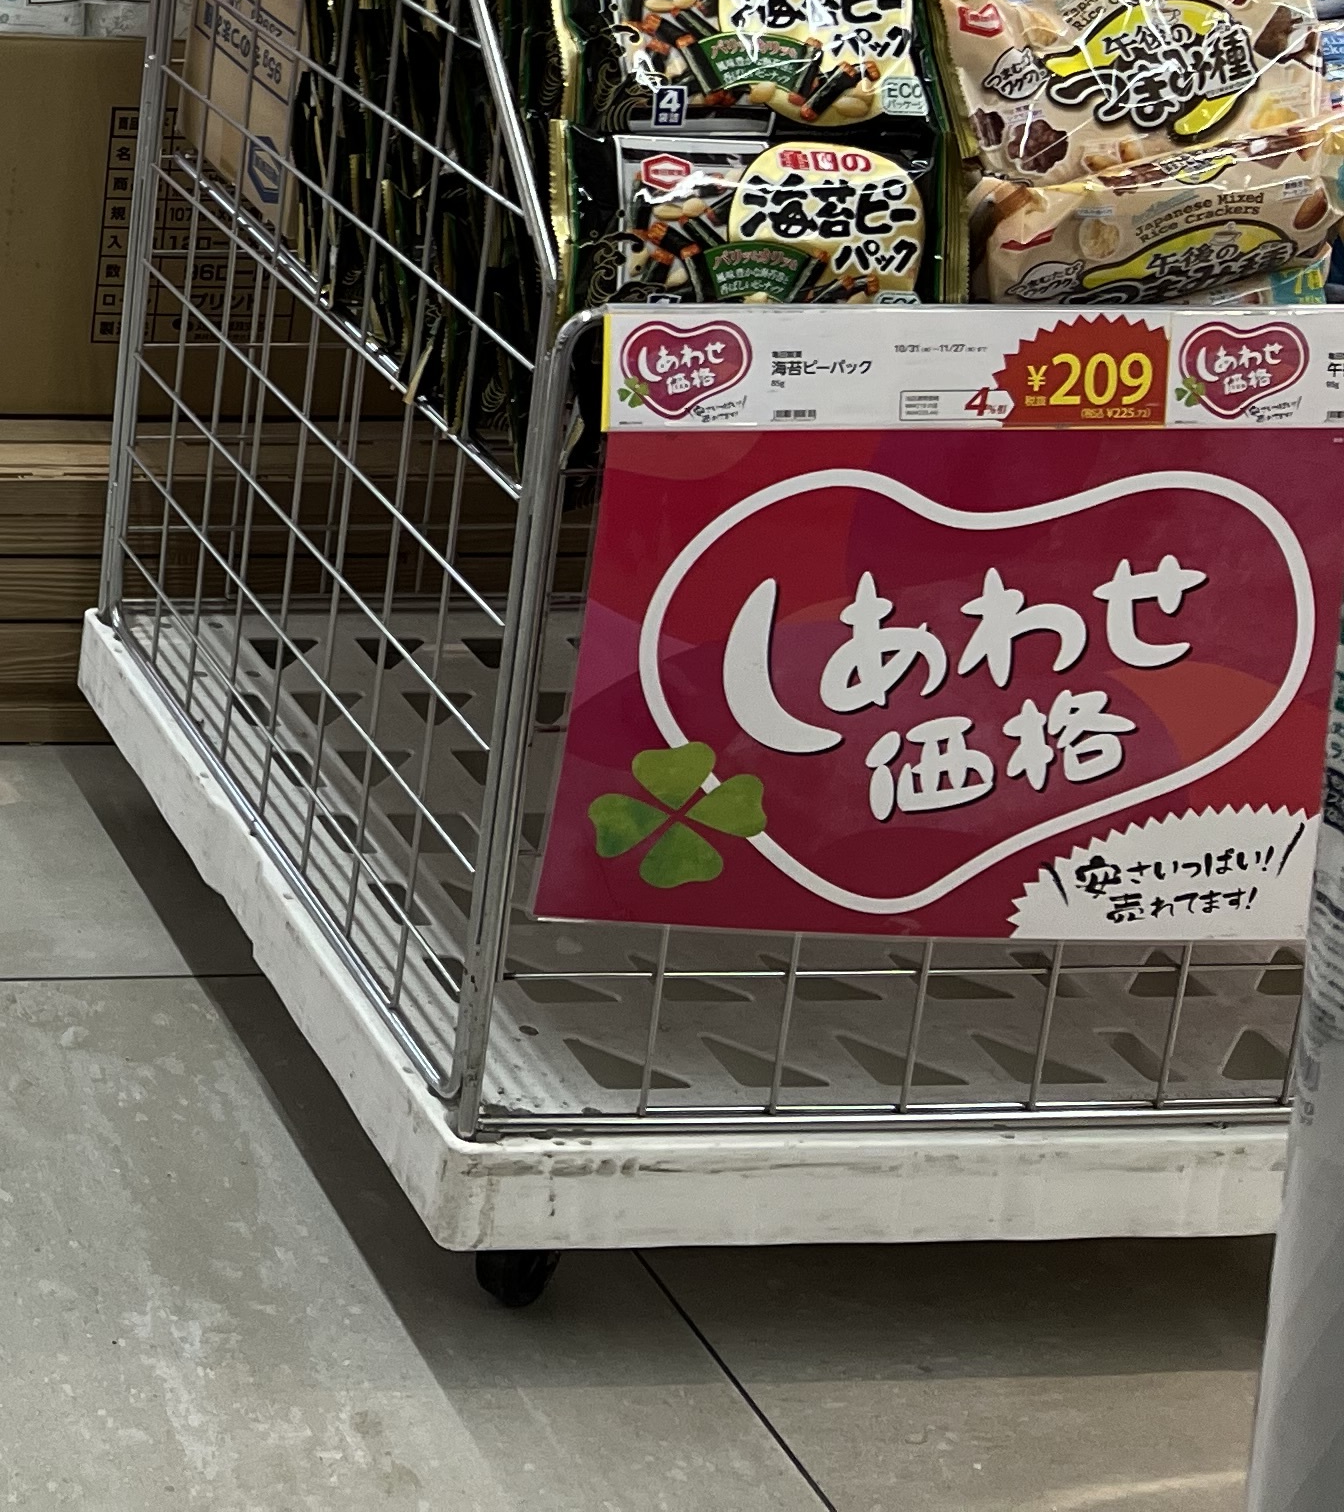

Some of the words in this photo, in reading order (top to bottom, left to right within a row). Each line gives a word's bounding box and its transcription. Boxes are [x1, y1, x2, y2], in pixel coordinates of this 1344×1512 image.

[830, 26, 912, 58] パック
[740, 174, 918, 237] 海苔ピー
[1134, 200, 1213, 237] Japanese
[1216, 191, 1265, 206] Mixed
[1140, 223, 1182, 244] Rice
[1183, 203, 1262, 226] Crackers
[834, 240, 919, 274] パック
[1146, 243, 1240, 278] 午後の
[637, 341, 728, 383] しあわせ
[666, 369, 717, 396] 価格
[770, 359, 873, 377] 海苔ピーパック
[1026, 352, 1154, 407] ¥209
[1196, 343, 1285, 383] しあわせ
[1223, 369, 1274, 396] 価格
[721, 553, 1209, 756] しあわせ
[866, 687, 1138, 823] 価格
[1074, 845, 1279, 898] 安さいっぱい!
[1106, 884, 1259, 926] 売れてます!
